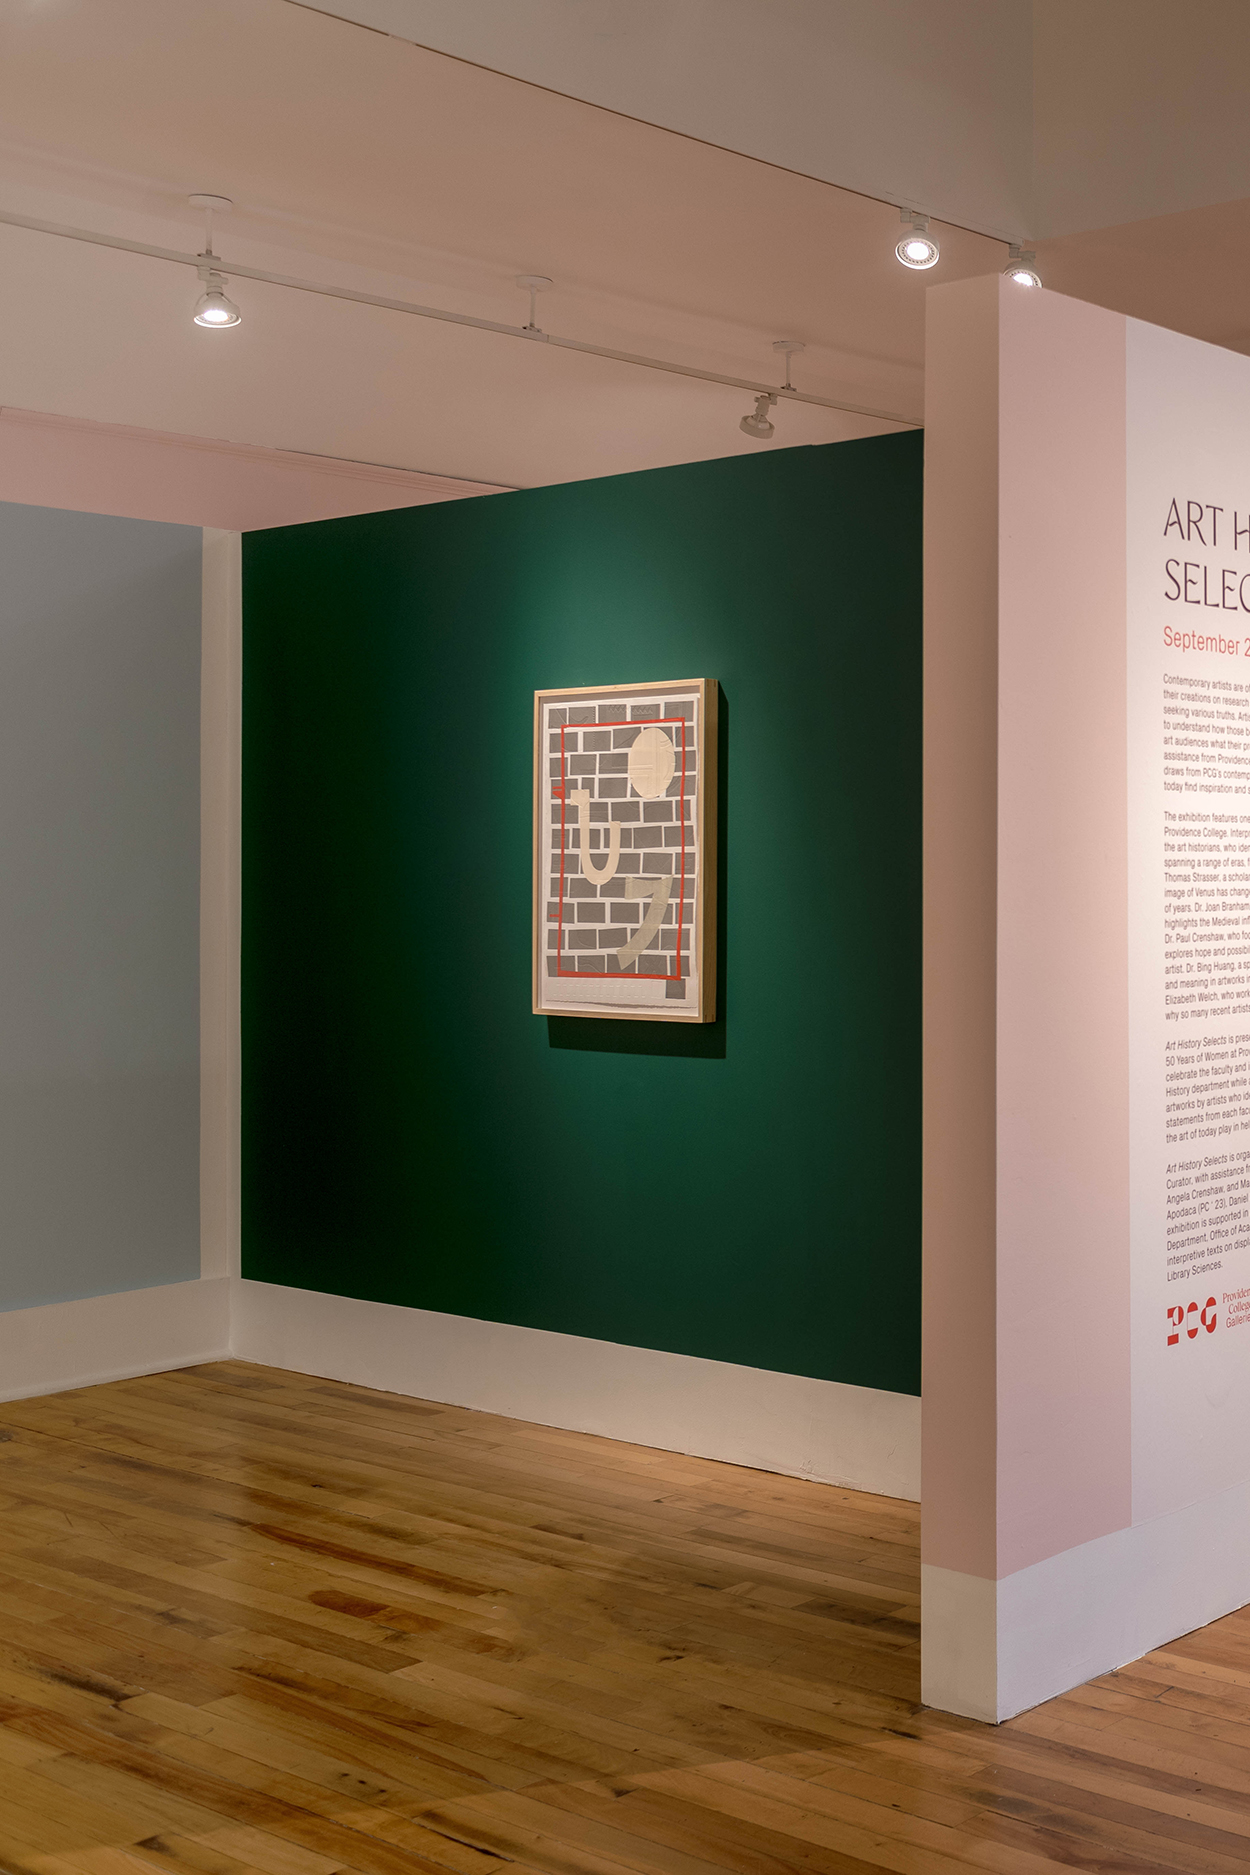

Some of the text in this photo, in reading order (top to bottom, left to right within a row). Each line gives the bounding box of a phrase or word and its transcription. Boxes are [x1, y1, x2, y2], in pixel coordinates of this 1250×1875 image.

[1163, 497, 1224, 546] ART
[1163, 626, 1240, 656] September
[1162, 673, 1210, 690] Contemporary
[1211, 680, 1232, 690] artists
[1233, 683, 1243, 691] are
[1163, 736, 1173, 745] art
[1174, 736, 1209, 748] audiences
[1210, 739, 1226, 749] what
[1227, 740, 1241, 750] their
[1163, 765, 1184, 776] draws
[1185, 767, 1201, 777] from
[1163, 827, 1201, 837] Providence
[1164, 888, 1185, 900] image
[1195, 888, 1215, 897] Venus
[1216, 887, 1228, 897] has
[1164, 949, 1193, 961] explores
[1194, 948, 1211, 959] hope
[1212, 946, 1225, 957] and
[1164, 993, 1196, 1006] Elizabeth
[1220, 990, 1234, 1001] who
[1165, 1011, 1179, 1022] why
[1190, 1009, 1208, 1019] many
[1209, 1006, 1230, 1017] recent
[1231, 1004, 1250, 1014] artists
[1165, 1087, 1190, 1098] History
[1191, 1080, 1229, 1095] department
[1230, 1077, 1247, 1088] while
[1165, 1114, 1204, 1129] statements
[1205, 1112, 1221, 1122] from
[1221, 1107, 1238, 1119] each
[1209, 1229, 1229, 1241] Office
[1166, 1269, 1190, 1282] Library
[1167, 1297, 1217, 1346] PCG
